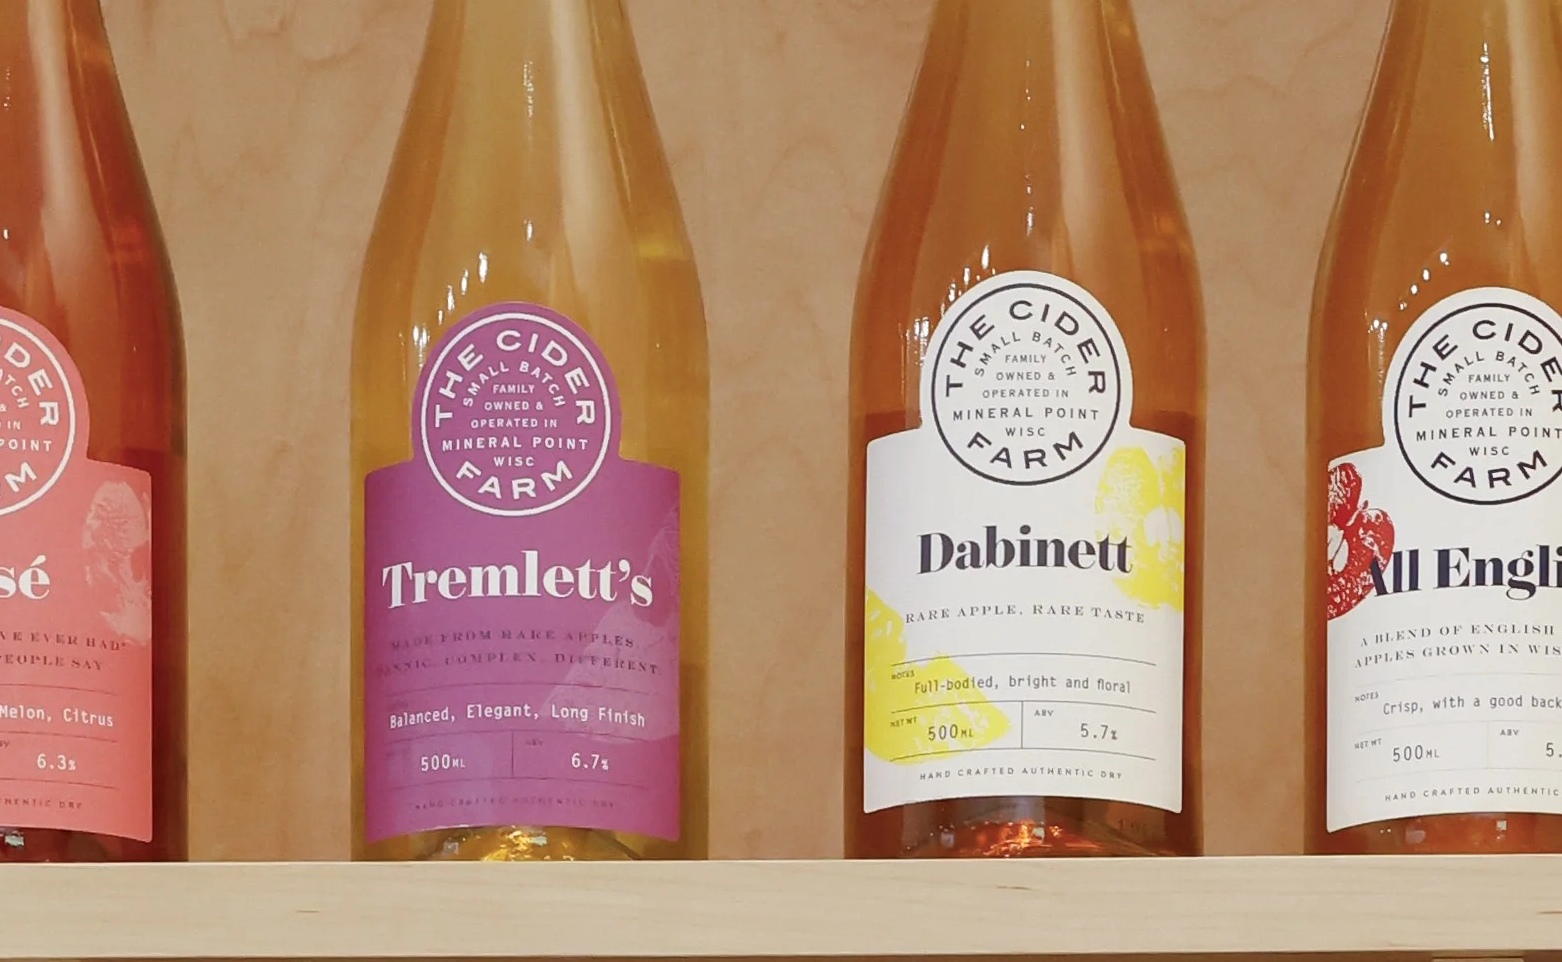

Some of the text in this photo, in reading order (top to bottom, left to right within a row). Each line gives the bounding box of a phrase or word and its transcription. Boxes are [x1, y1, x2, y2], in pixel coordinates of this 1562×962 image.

[946, 300, 1106, 397] THE CIDER
[975, 331, 1077, 377] SMALL BATCH
[435, 330, 596, 427] THE CIDER
[463, 361, 566, 407] SMALL BATCH
[1409, 334, 1458, 418] THE
[1438, 351, 1540, 397] SMALL BATCH
[953, 407, 1099, 420] MINERAL POINT
[442, 437, 588, 451] MINERAL POINT
[1416, 426, 1562, 441] MINERAL POINT
[967, 431, 1084, 469] FARM
[456, 460, 573, 500] FARM
[1430, 450, 1548, 488] FARM
[917, 525, 1132, 575] Dabinett
[382, 550, 653, 609] Tremlett's
[906, 605, 1145, 624] RARE APPLE, RARE TASTE
[1361, 638, 1368, 646] A
[1375, 628, 1431, 644] BLEND
[1440, 625, 1463, 636] OF
[1471, 624, 1554, 635] ENGLISH
[1354, 644, 1519, 668] APPLES GROWN IN
[915, 675, 1131, 694] Full-bodied, bright and floral
[0, 705, 52, 722] Melon,
[63, 708, 114, 727] Citrus
[390, 704, 645, 729] Balanced, Elegant, Long Finish
[1383, 700, 1424, 715] Crisp,
[1433, 697, 1464, 709] with
[1473, 698, 1480, 707] a
[1489, 695, 1523, 709] good
[1081, 723, 1118, 740] 5.7%
[37, 754, 77, 771] 6.3%
[571, 753, 610, 770] 6.7%
[920, 767, 1123, 780] HAND CRAFTED AUTHENTIC DRY
[1385, 791, 1416, 801] HAND
[1423, 787, 1480, 797] CRAFTED
[1488, 787, 1559, 796] AUTHENTIC
